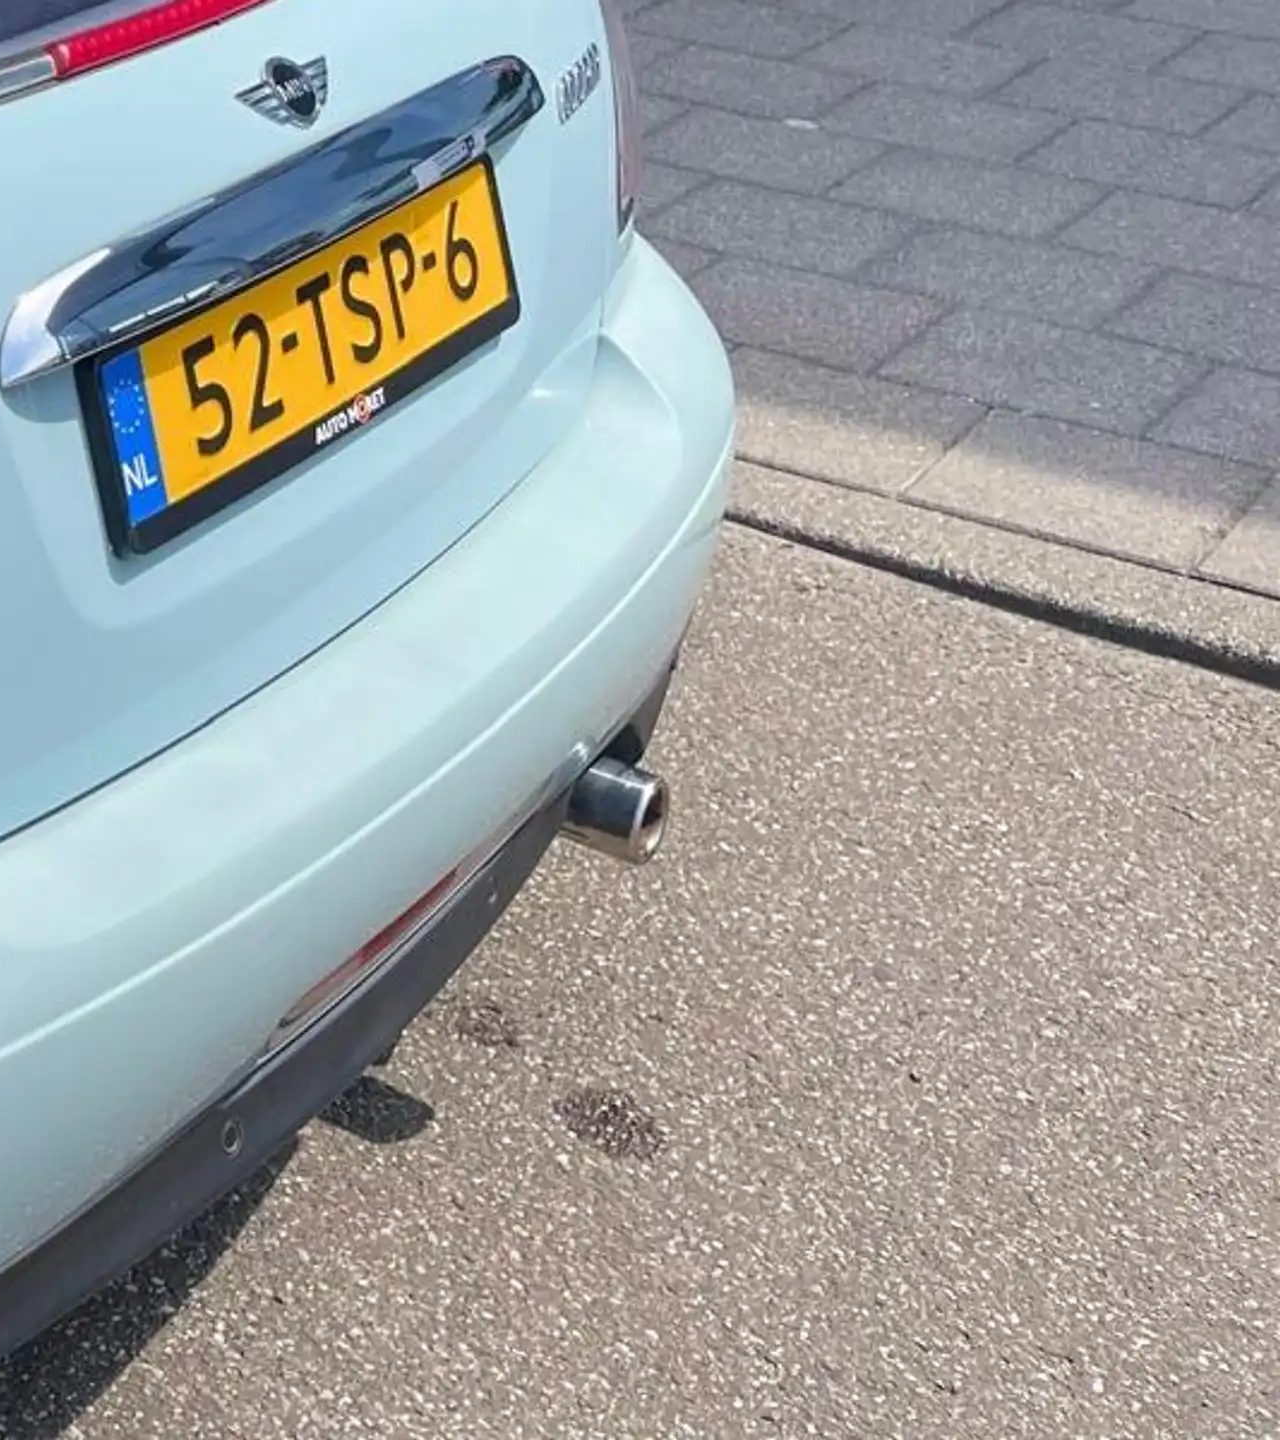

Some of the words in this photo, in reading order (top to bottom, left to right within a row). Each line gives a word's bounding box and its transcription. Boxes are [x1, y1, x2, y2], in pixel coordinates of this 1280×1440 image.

[181, 202, 479, 457] 52-TSP-6
[315, 411, 348, 445] AUTO
[121, 452, 158, 496] NL
